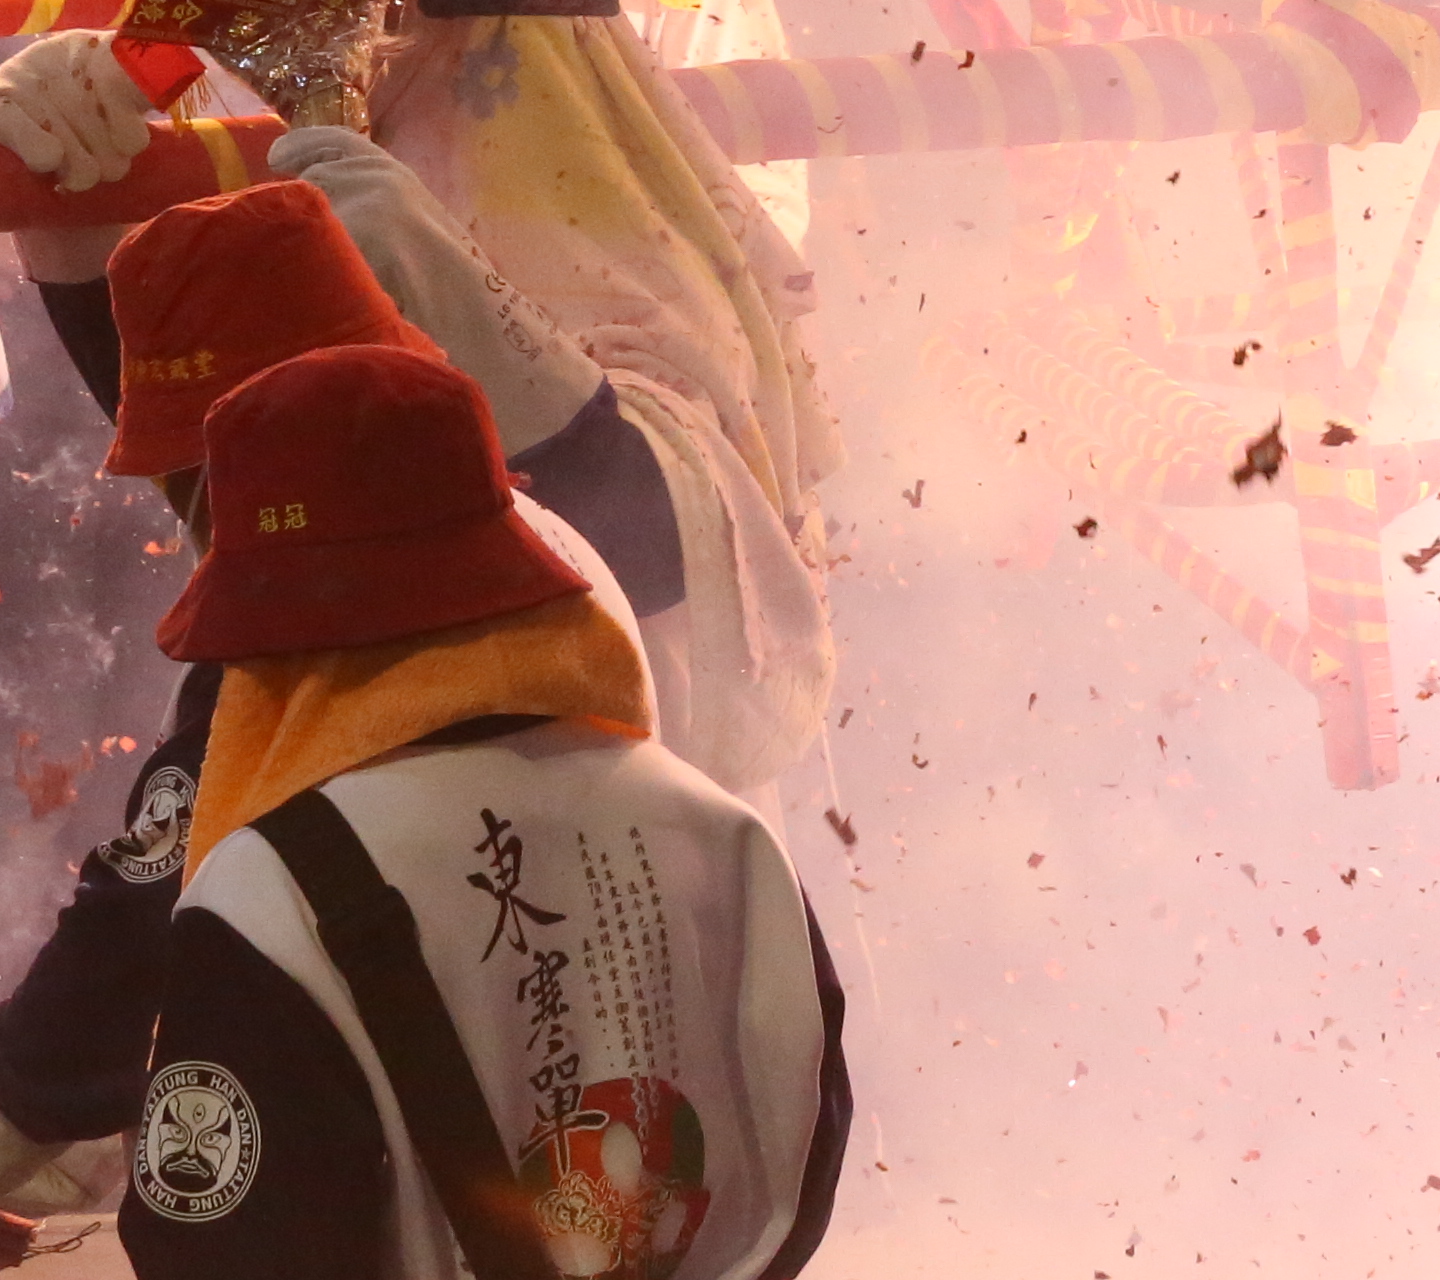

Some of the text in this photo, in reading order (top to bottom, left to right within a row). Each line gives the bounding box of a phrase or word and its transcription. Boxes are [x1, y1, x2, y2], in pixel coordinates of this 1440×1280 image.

[143, 1071, 252, 1145] TAITUNG HAN DAN
[147, 1180, 177, 1208] HAN
[189, 1162, 249, 1211] TAITUNG
